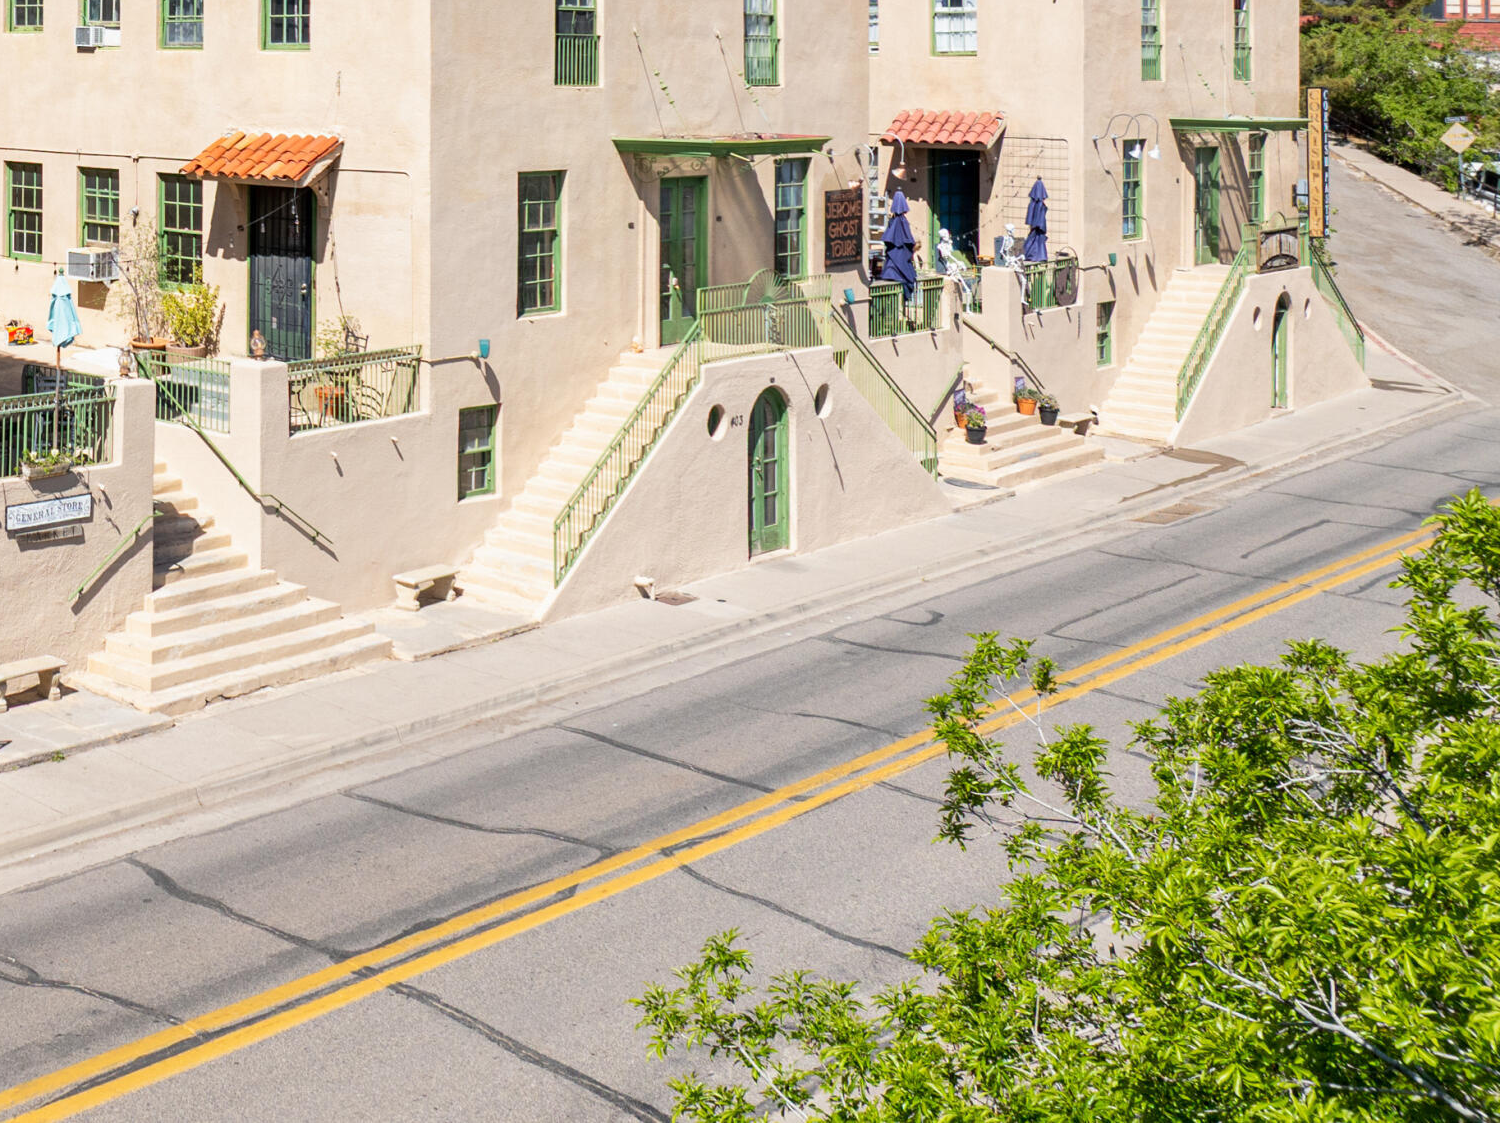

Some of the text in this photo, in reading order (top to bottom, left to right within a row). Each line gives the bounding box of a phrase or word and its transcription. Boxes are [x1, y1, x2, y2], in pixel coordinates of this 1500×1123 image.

[826, 200, 862, 219] JEROME
[829, 219, 859, 238] GHOST
[830, 239, 857, 257] TOURS
[16, 501, 84, 523] GENERAL STORE
